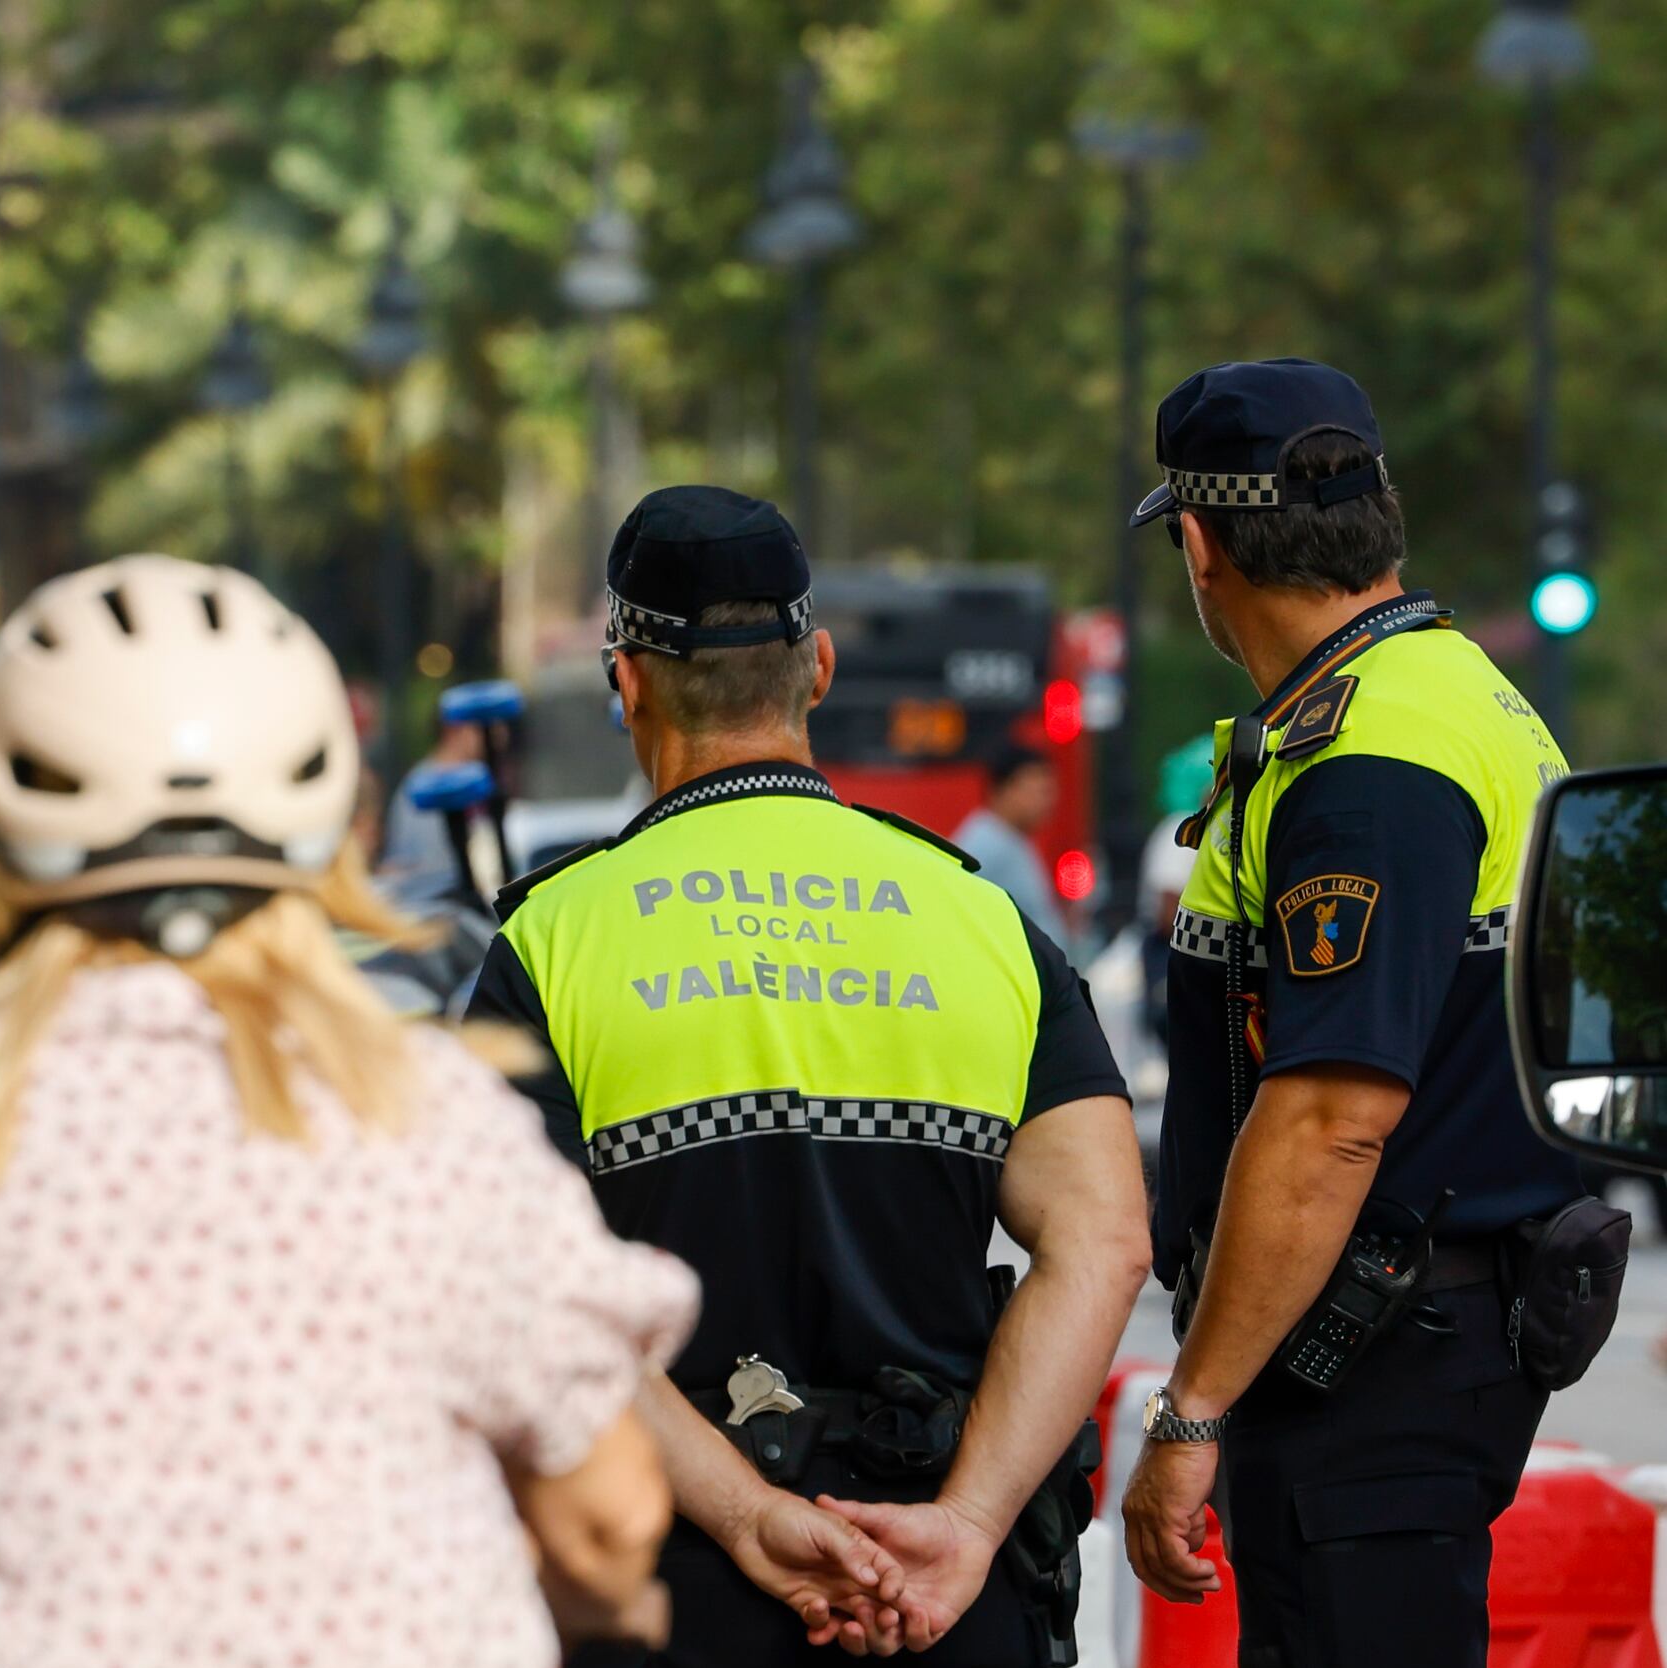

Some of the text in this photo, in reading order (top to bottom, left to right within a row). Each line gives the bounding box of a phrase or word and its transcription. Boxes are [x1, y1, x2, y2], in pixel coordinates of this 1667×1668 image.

[633, 870, 912, 917] POLICIA
[1284, 879, 1365, 912] POLICIA LOCAL
[711, 914, 847, 945] LOCAL
[631, 952, 940, 1012] VALÈNCIA
